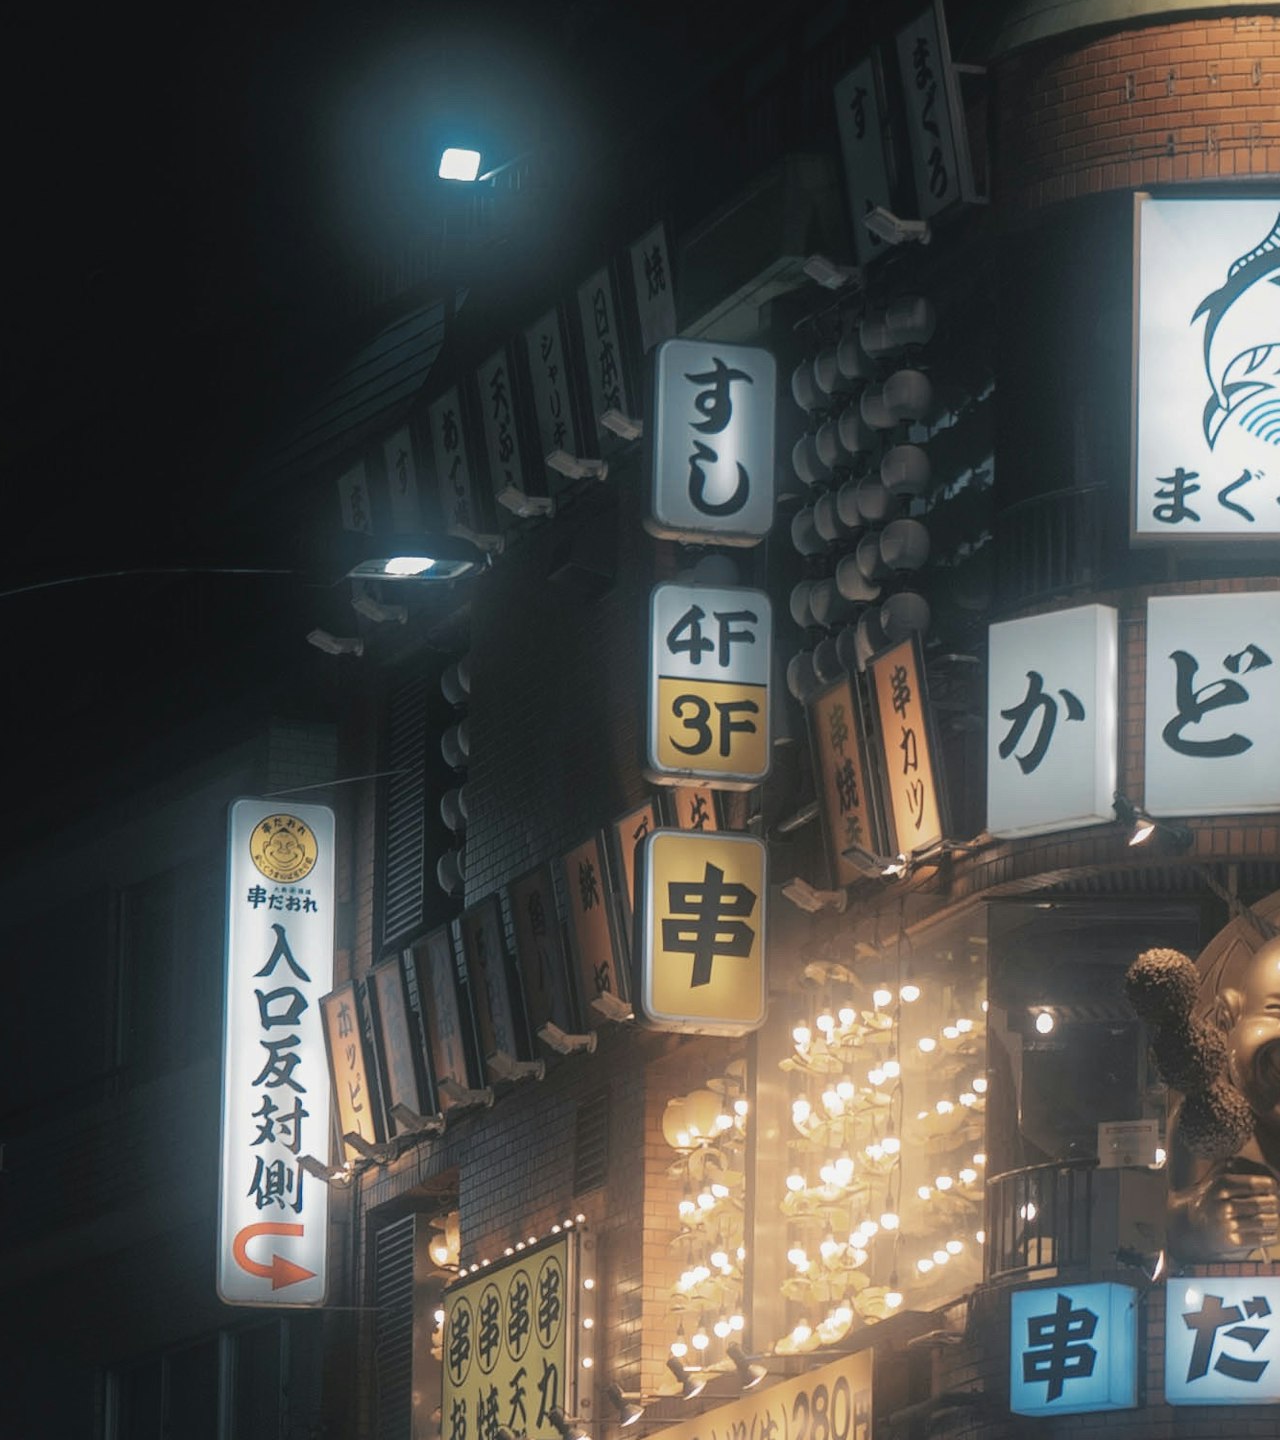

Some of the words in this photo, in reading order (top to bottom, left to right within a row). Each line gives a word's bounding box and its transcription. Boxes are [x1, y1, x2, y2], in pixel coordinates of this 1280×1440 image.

[683, 356, 755, 518] すし
[666, 603, 759, 668] 4F
[669, 694, 760, 758] 3F
[888, 664, 926, 832] 串カツ
[247, 884, 318, 913] 串だおれ
[661, 860, 759, 989] 串
[246, 922, 312, 1215] 入口反対側
